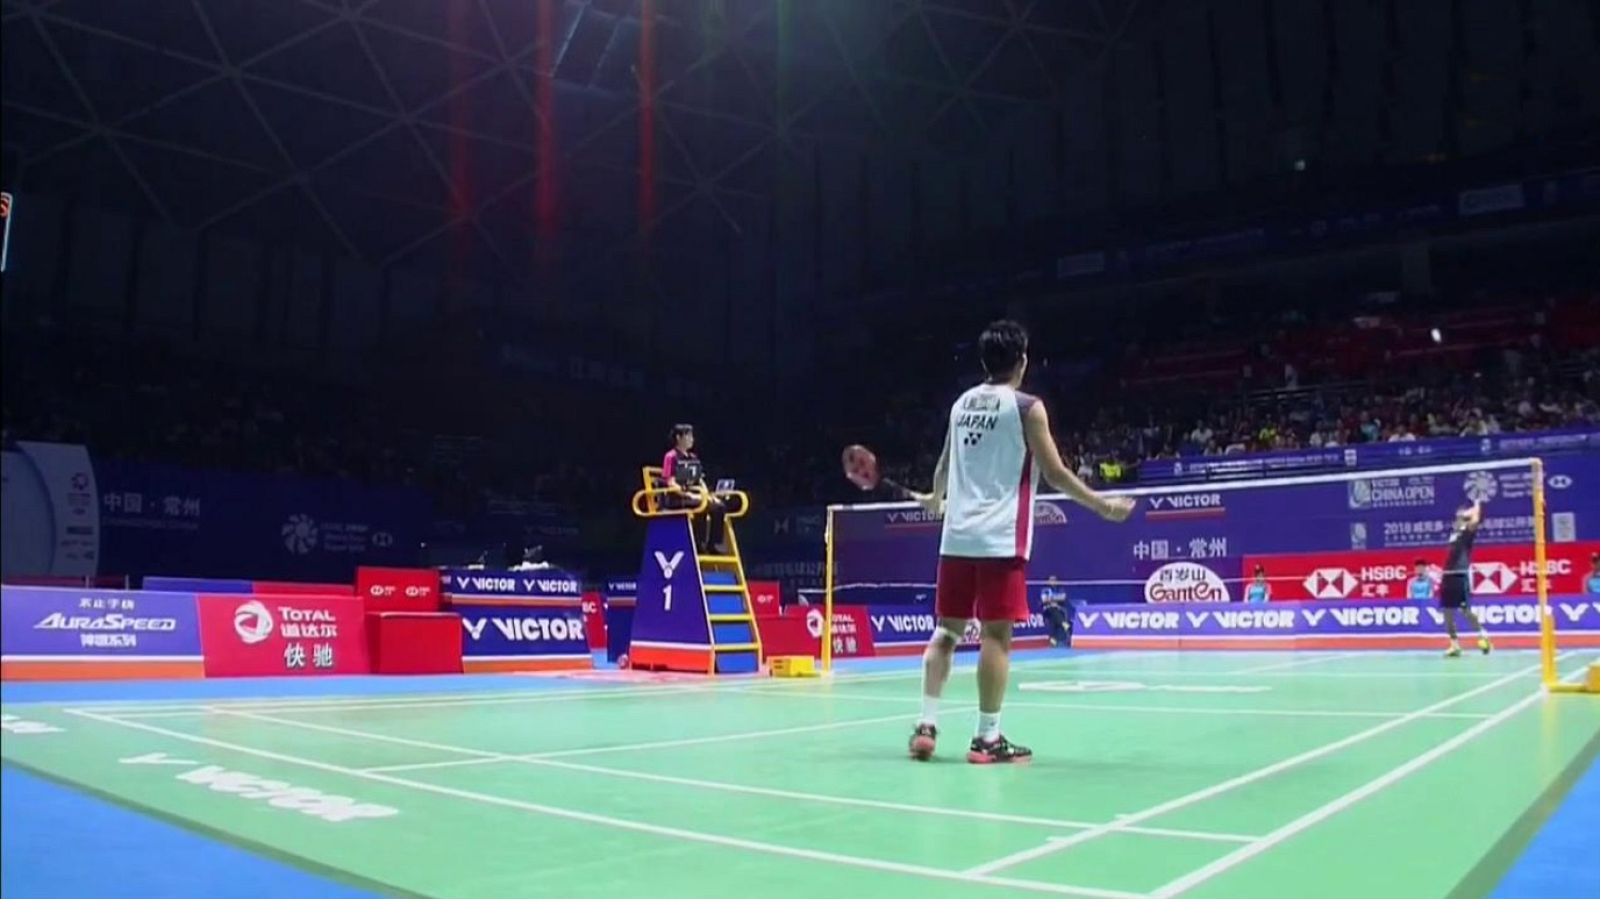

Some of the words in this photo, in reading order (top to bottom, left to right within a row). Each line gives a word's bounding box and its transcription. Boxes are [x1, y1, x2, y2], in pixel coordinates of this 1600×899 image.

[957, 413, 999, 431] JAPAN
[1167, 494, 1221, 508] VICTOR
[1371, 487, 1404, 501] CHINA
[1405, 485, 1435, 500] OPEN
[1361, 565, 1408, 581] HSBC
[1520, 559, 1572, 576] HBC
[472, 577, 516, 591] VICTOR
[537, 579, 578, 593] VICTOR
[662, 584, 672, 610] 1
[278, 606, 336, 622] TOTAL
[1102, 612, 1180, 629] VICTOR
[1212, 610, 1296, 629] VICTOR
[1330, 606, 1419, 625] VICTOR
[492, 618, 585, 641] VICTOR
[887, 615, 936, 632] VICTOR
[175, 764, 400, 823] VICTOR
